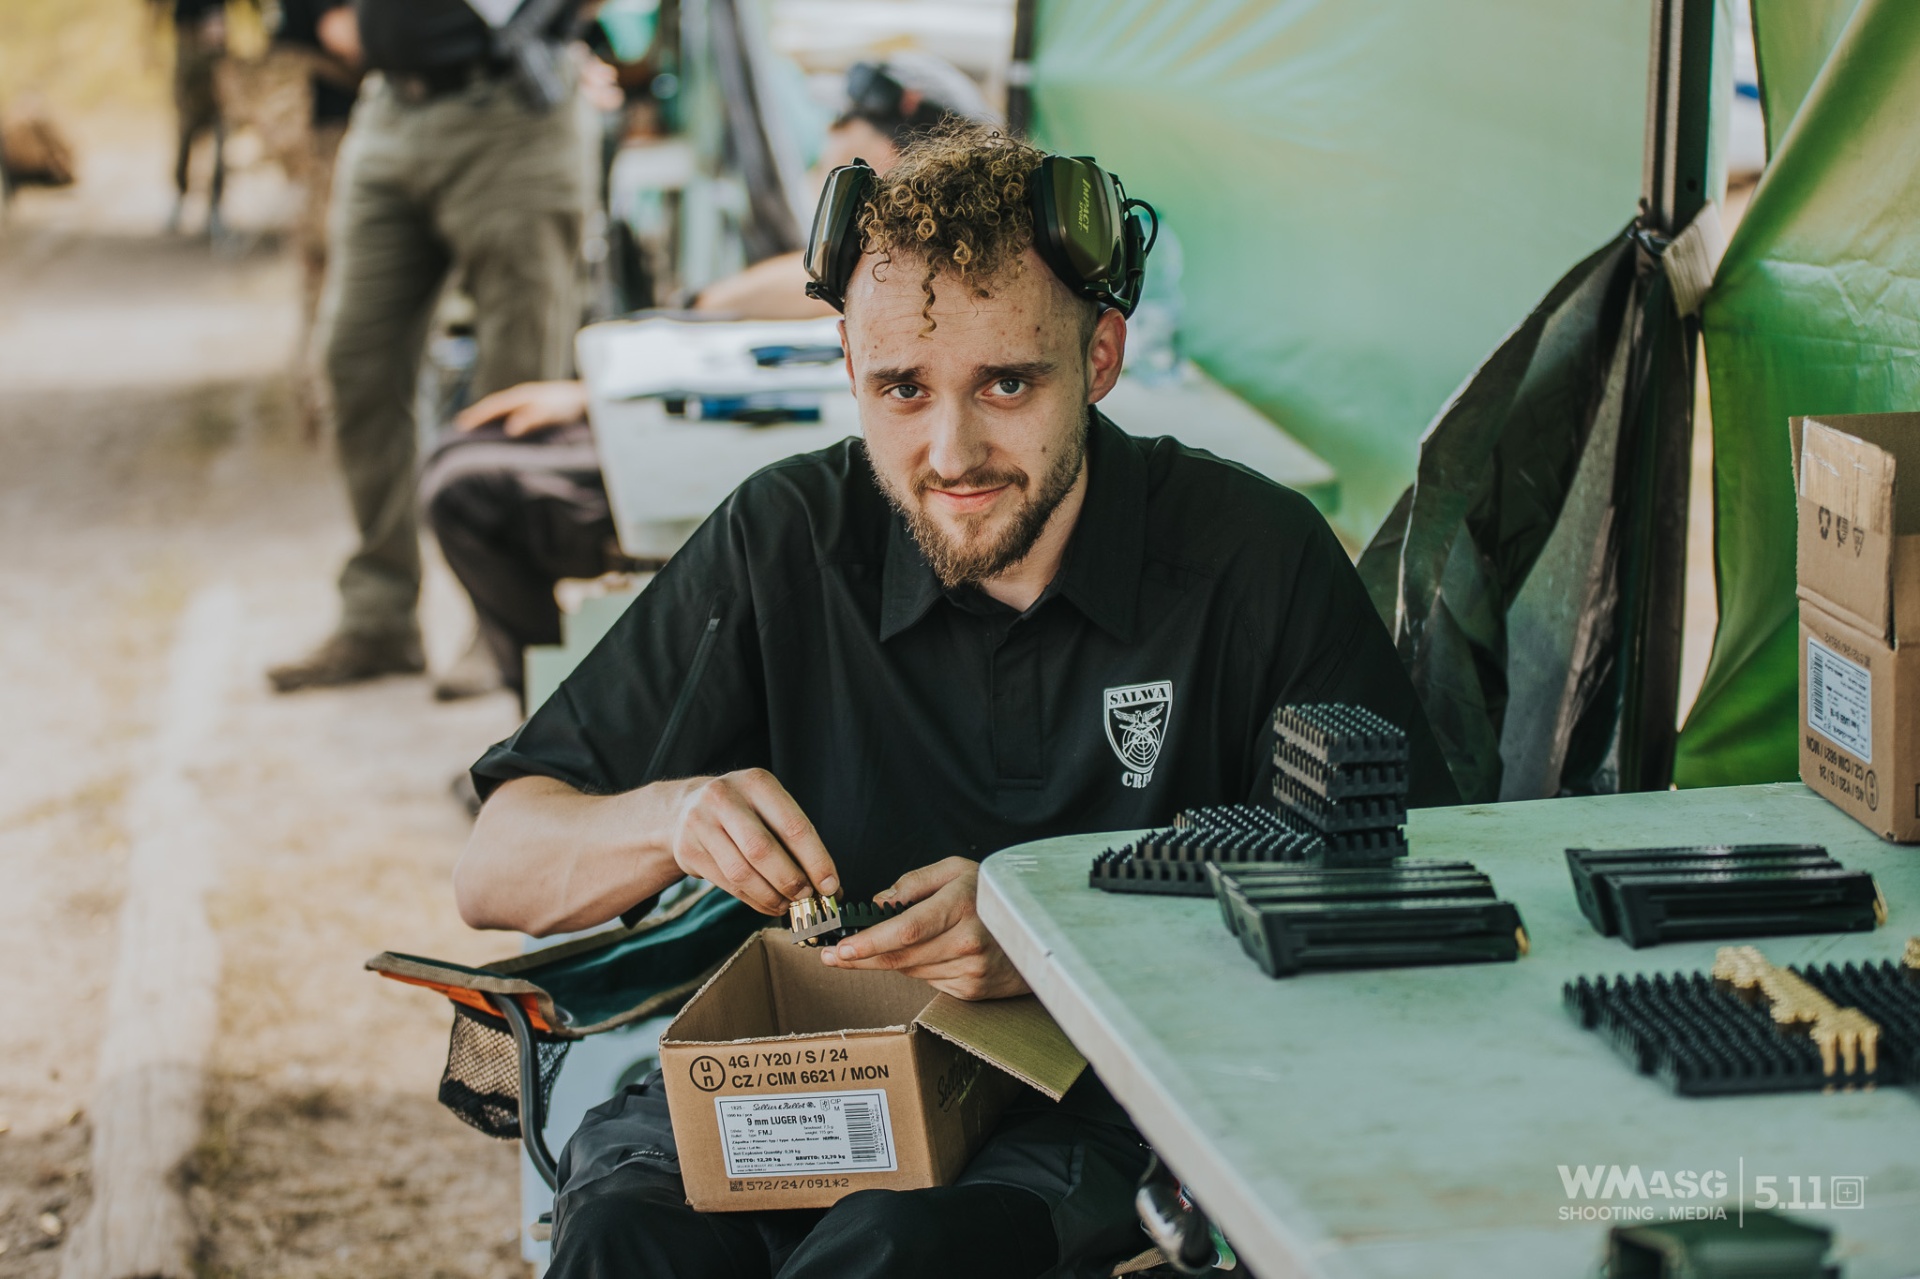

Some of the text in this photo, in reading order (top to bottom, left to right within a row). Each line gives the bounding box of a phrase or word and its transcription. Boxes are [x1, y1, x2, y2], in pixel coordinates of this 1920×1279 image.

[1082, 178, 1091, 233] IMPACT
[1109, 687, 1167, 706] SALWA
[728, 1048, 848, 1069] 4G / Y20 / S / 24
[731, 1064, 890, 1089] CZ / CIM 6621 / MON
[746, 1117, 753, 1126] 9
[770, 1115, 798, 1126] LUGER
